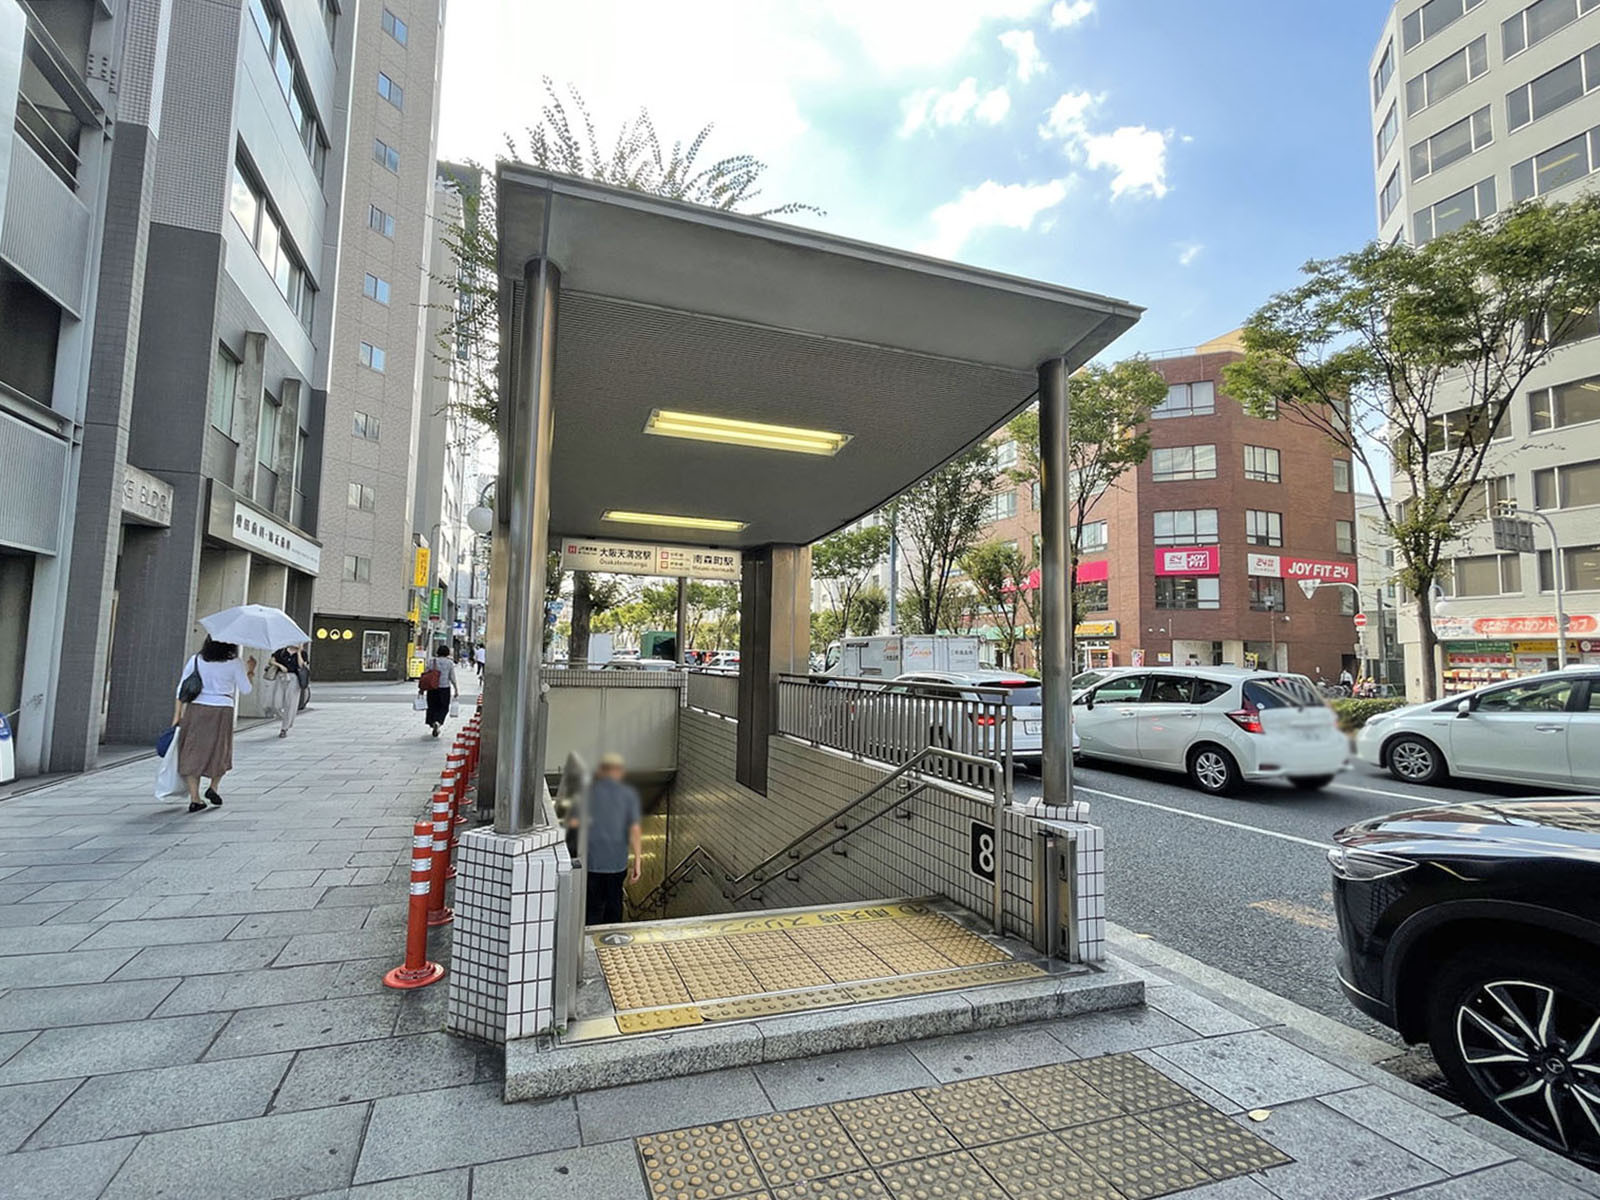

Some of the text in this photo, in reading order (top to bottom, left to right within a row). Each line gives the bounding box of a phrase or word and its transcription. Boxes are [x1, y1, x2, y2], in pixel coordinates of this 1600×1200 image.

[600, 547, 652, 561] 大阪天満宮駅
[693, 554, 734, 566] 南森町駅
[1187, 554, 1206, 562] JOY
[1288, 562, 1313, 576] JOY
[1313, 564, 1332, 577] FIT
[1333, 566, 1349, 579] 24
[979, 833, 995, 873] 8
